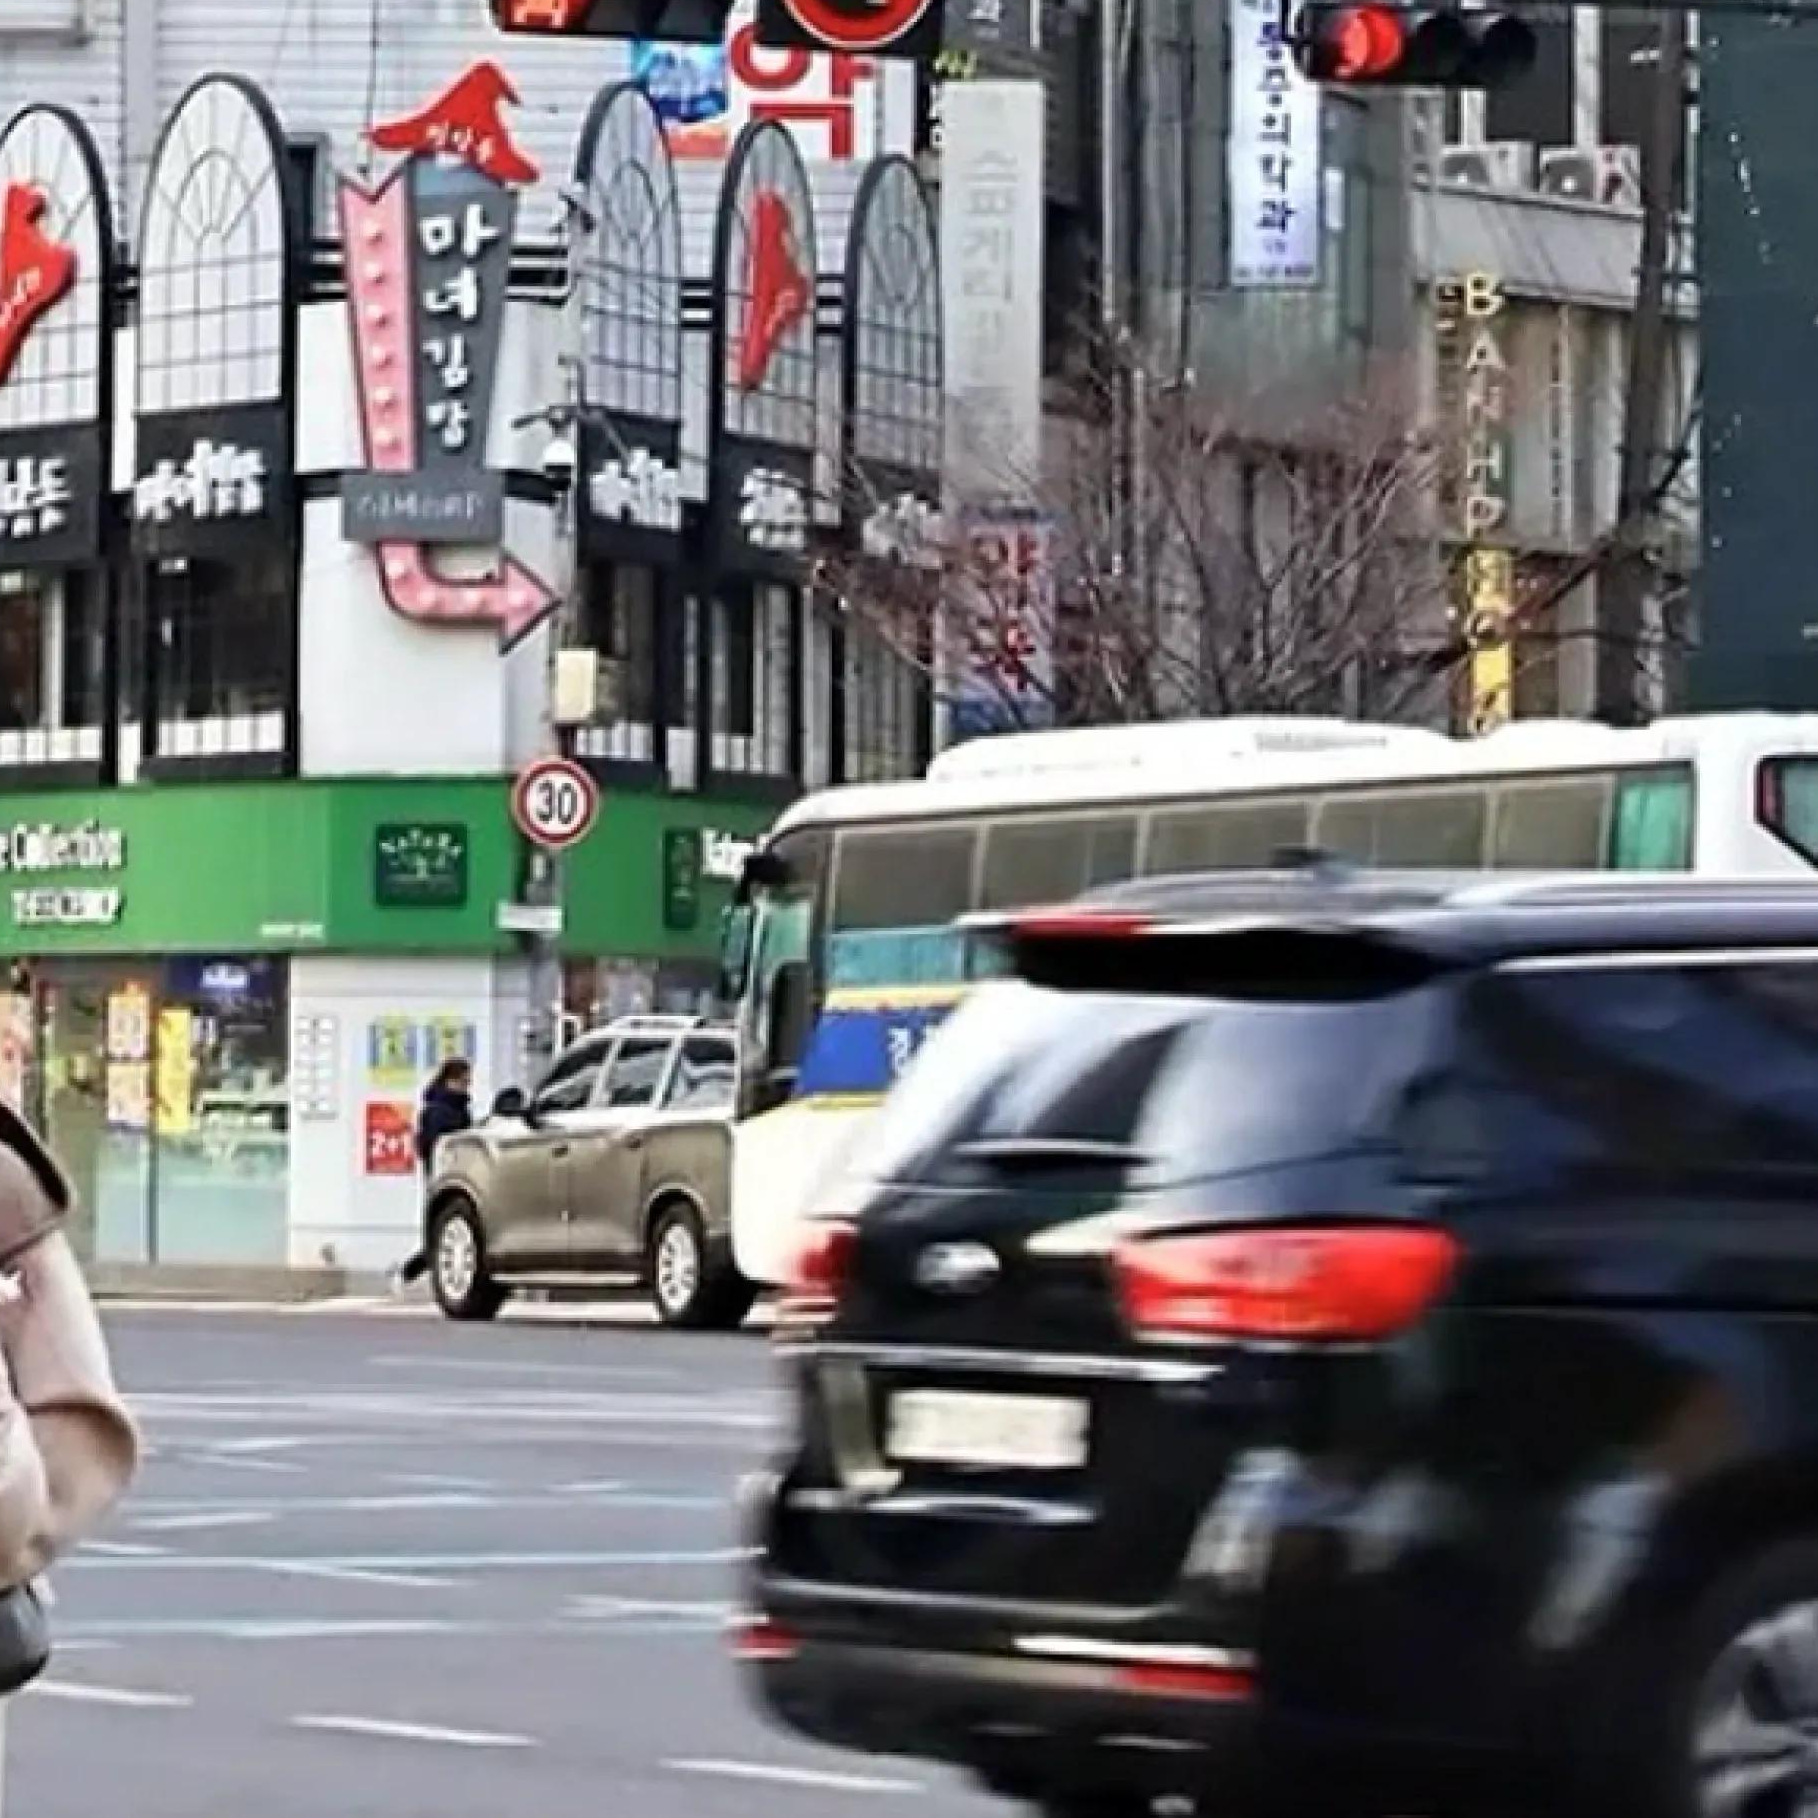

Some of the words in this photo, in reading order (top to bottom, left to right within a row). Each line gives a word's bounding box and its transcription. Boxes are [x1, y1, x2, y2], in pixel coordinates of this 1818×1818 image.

[419, 202, 501, 451] 마녀김밥
[535, 783, 579, 825] 30
[11, 818, 123, 871] Collection
